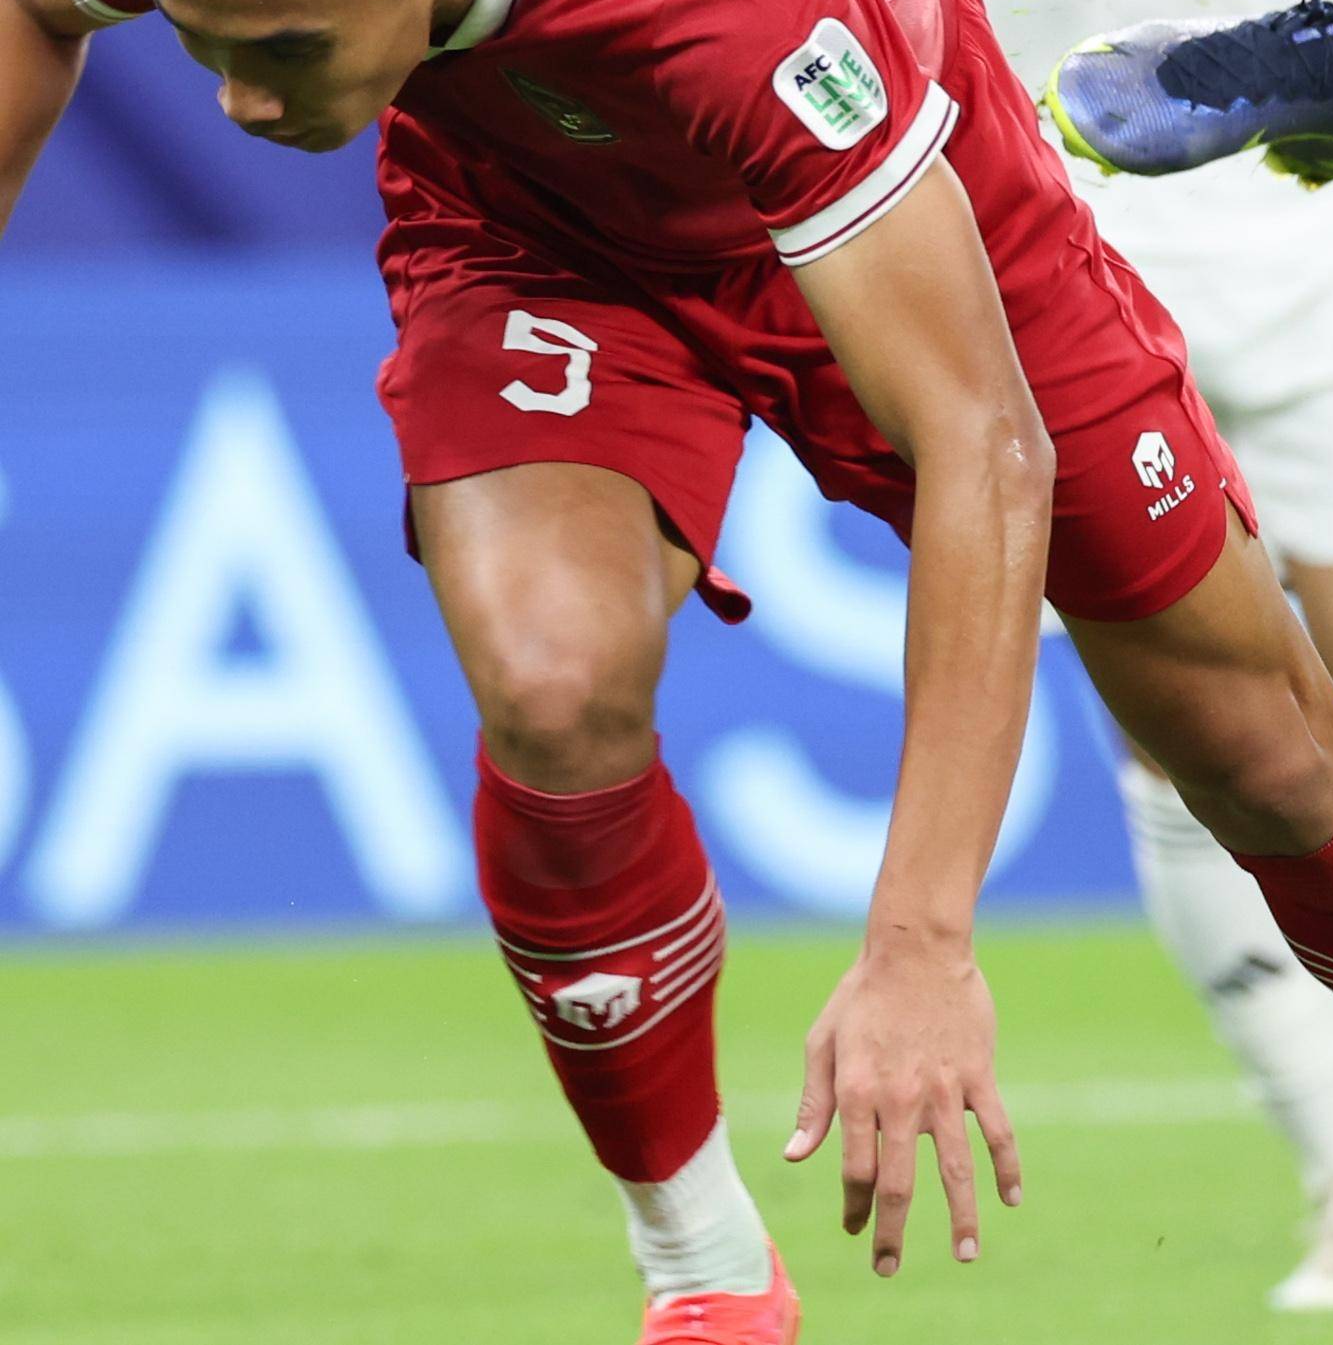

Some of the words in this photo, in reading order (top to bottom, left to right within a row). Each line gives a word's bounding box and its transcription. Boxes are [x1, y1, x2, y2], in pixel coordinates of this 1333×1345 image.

[794, 54, 832, 92] AFC
[804, 49, 863, 113] LIVE
[499, 309, 599, 417] 5
[1147, 475, 1195, 521] MILLS
